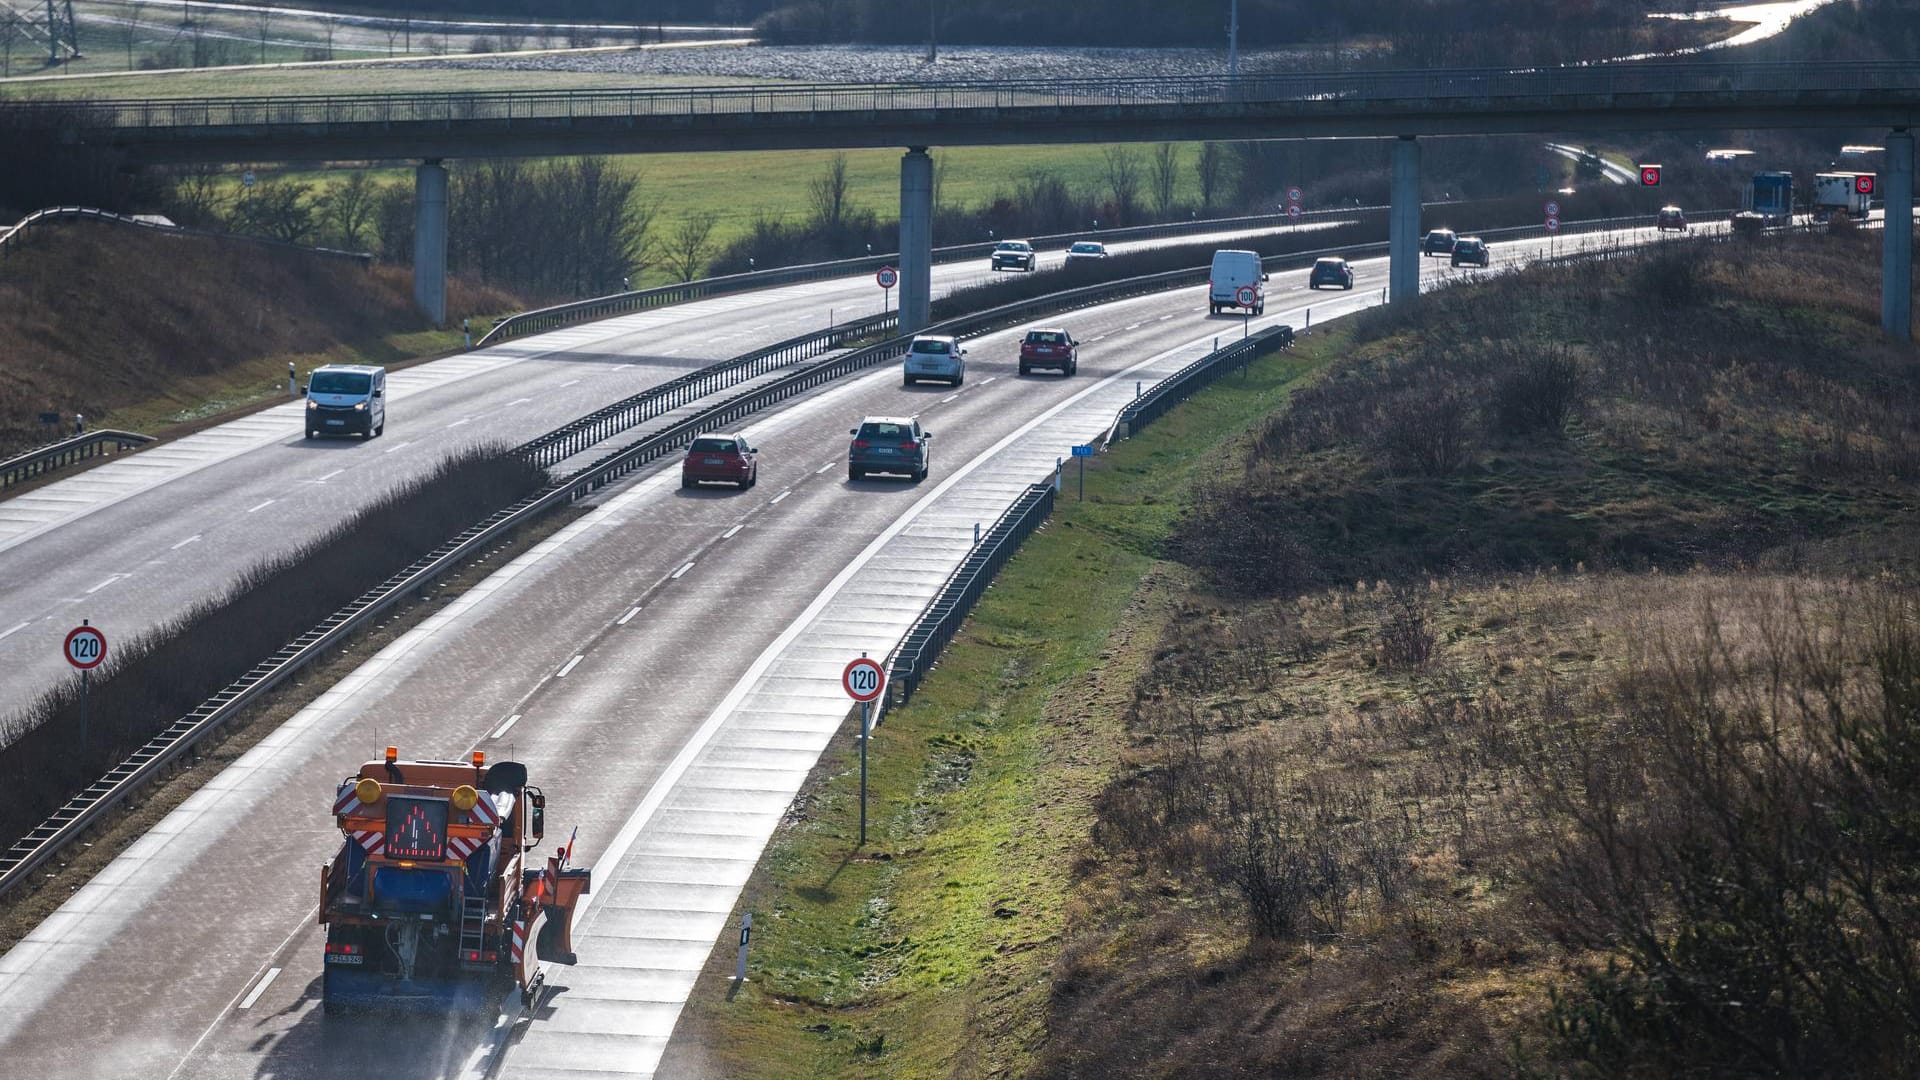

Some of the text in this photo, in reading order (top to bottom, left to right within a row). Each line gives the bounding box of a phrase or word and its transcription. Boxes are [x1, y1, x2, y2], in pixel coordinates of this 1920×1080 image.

[1646, 173, 1655, 181] 80
[1860, 181, 1870, 189] 80
[881, 273, 894, 283] 100
[1241, 291, 1253, 301] 100
[72, 638, 98, 657] 120
[851, 670, 876, 689] 120
